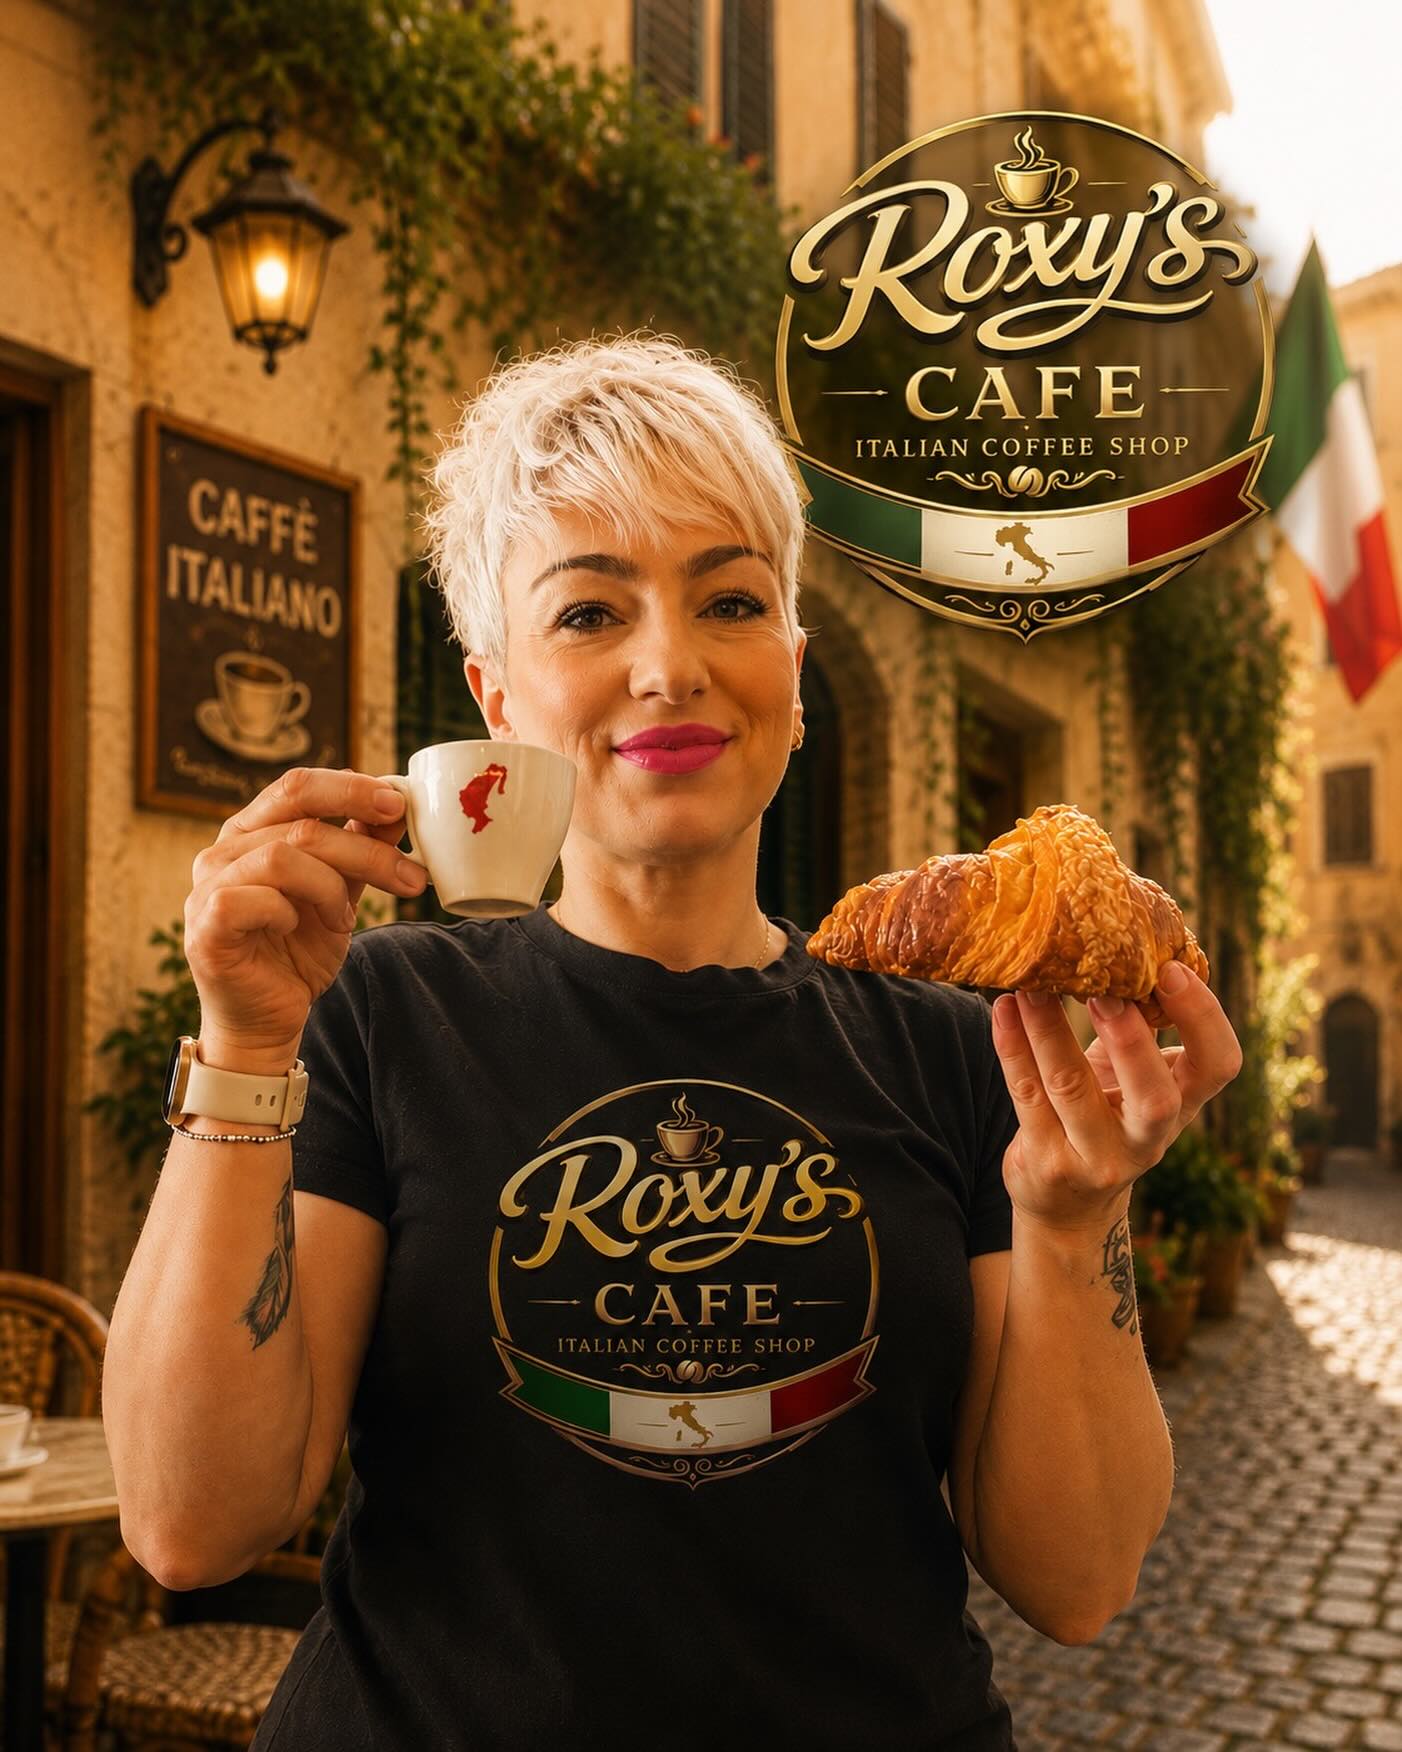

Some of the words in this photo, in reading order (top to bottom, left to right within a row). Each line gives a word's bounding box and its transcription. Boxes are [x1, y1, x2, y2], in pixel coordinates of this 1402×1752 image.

[166, 544, 342, 639] ITALIANO
[499, 1135, 863, 1273] Roxy's
[595, 1284, 781, 1326] CAFE
[558, 1338, 646, 1353] ITALIAN
[657, 1338, 743, 1353] COFFEE
[755, 1338, 817, 1353] SHOP
